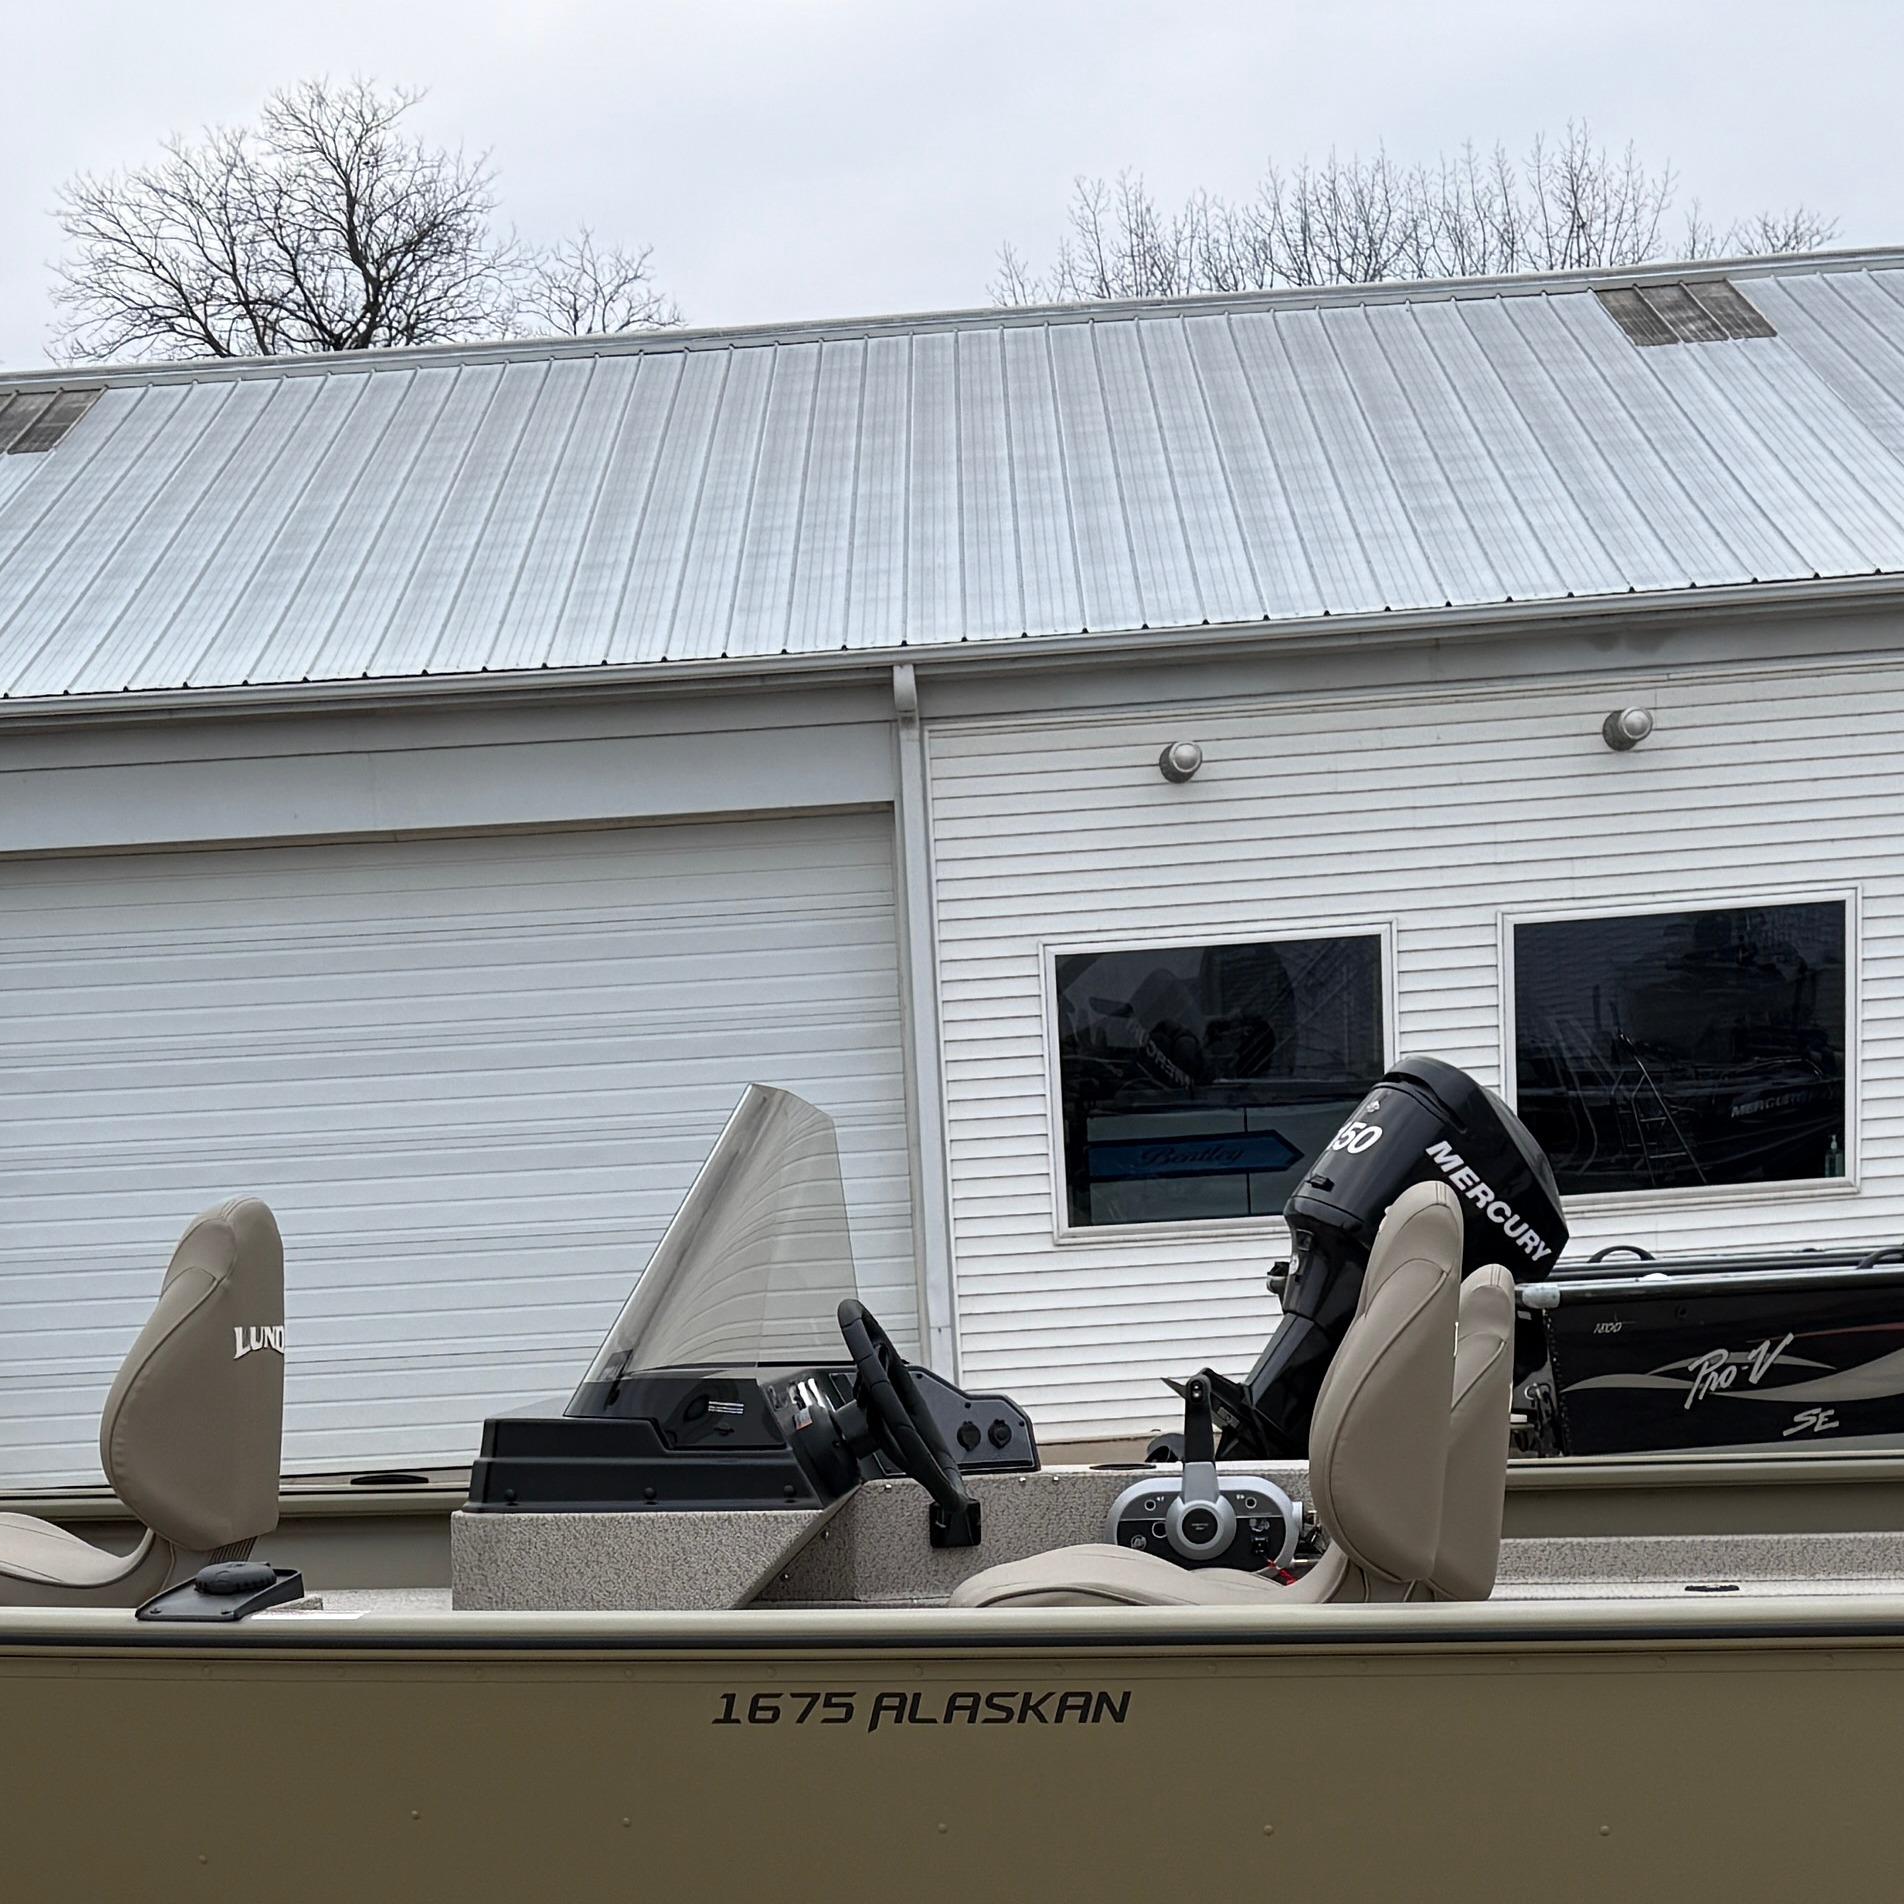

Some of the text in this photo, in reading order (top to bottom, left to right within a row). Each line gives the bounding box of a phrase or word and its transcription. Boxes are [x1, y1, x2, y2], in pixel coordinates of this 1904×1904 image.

[1425, 1139, 1553, 1262] MERCURY
[232, 1325, 285, 1361] LUND
[1782, 1407, 1840, 1437] SE
[711, 1690, 1133, 1733] 1675 ALASKAN
